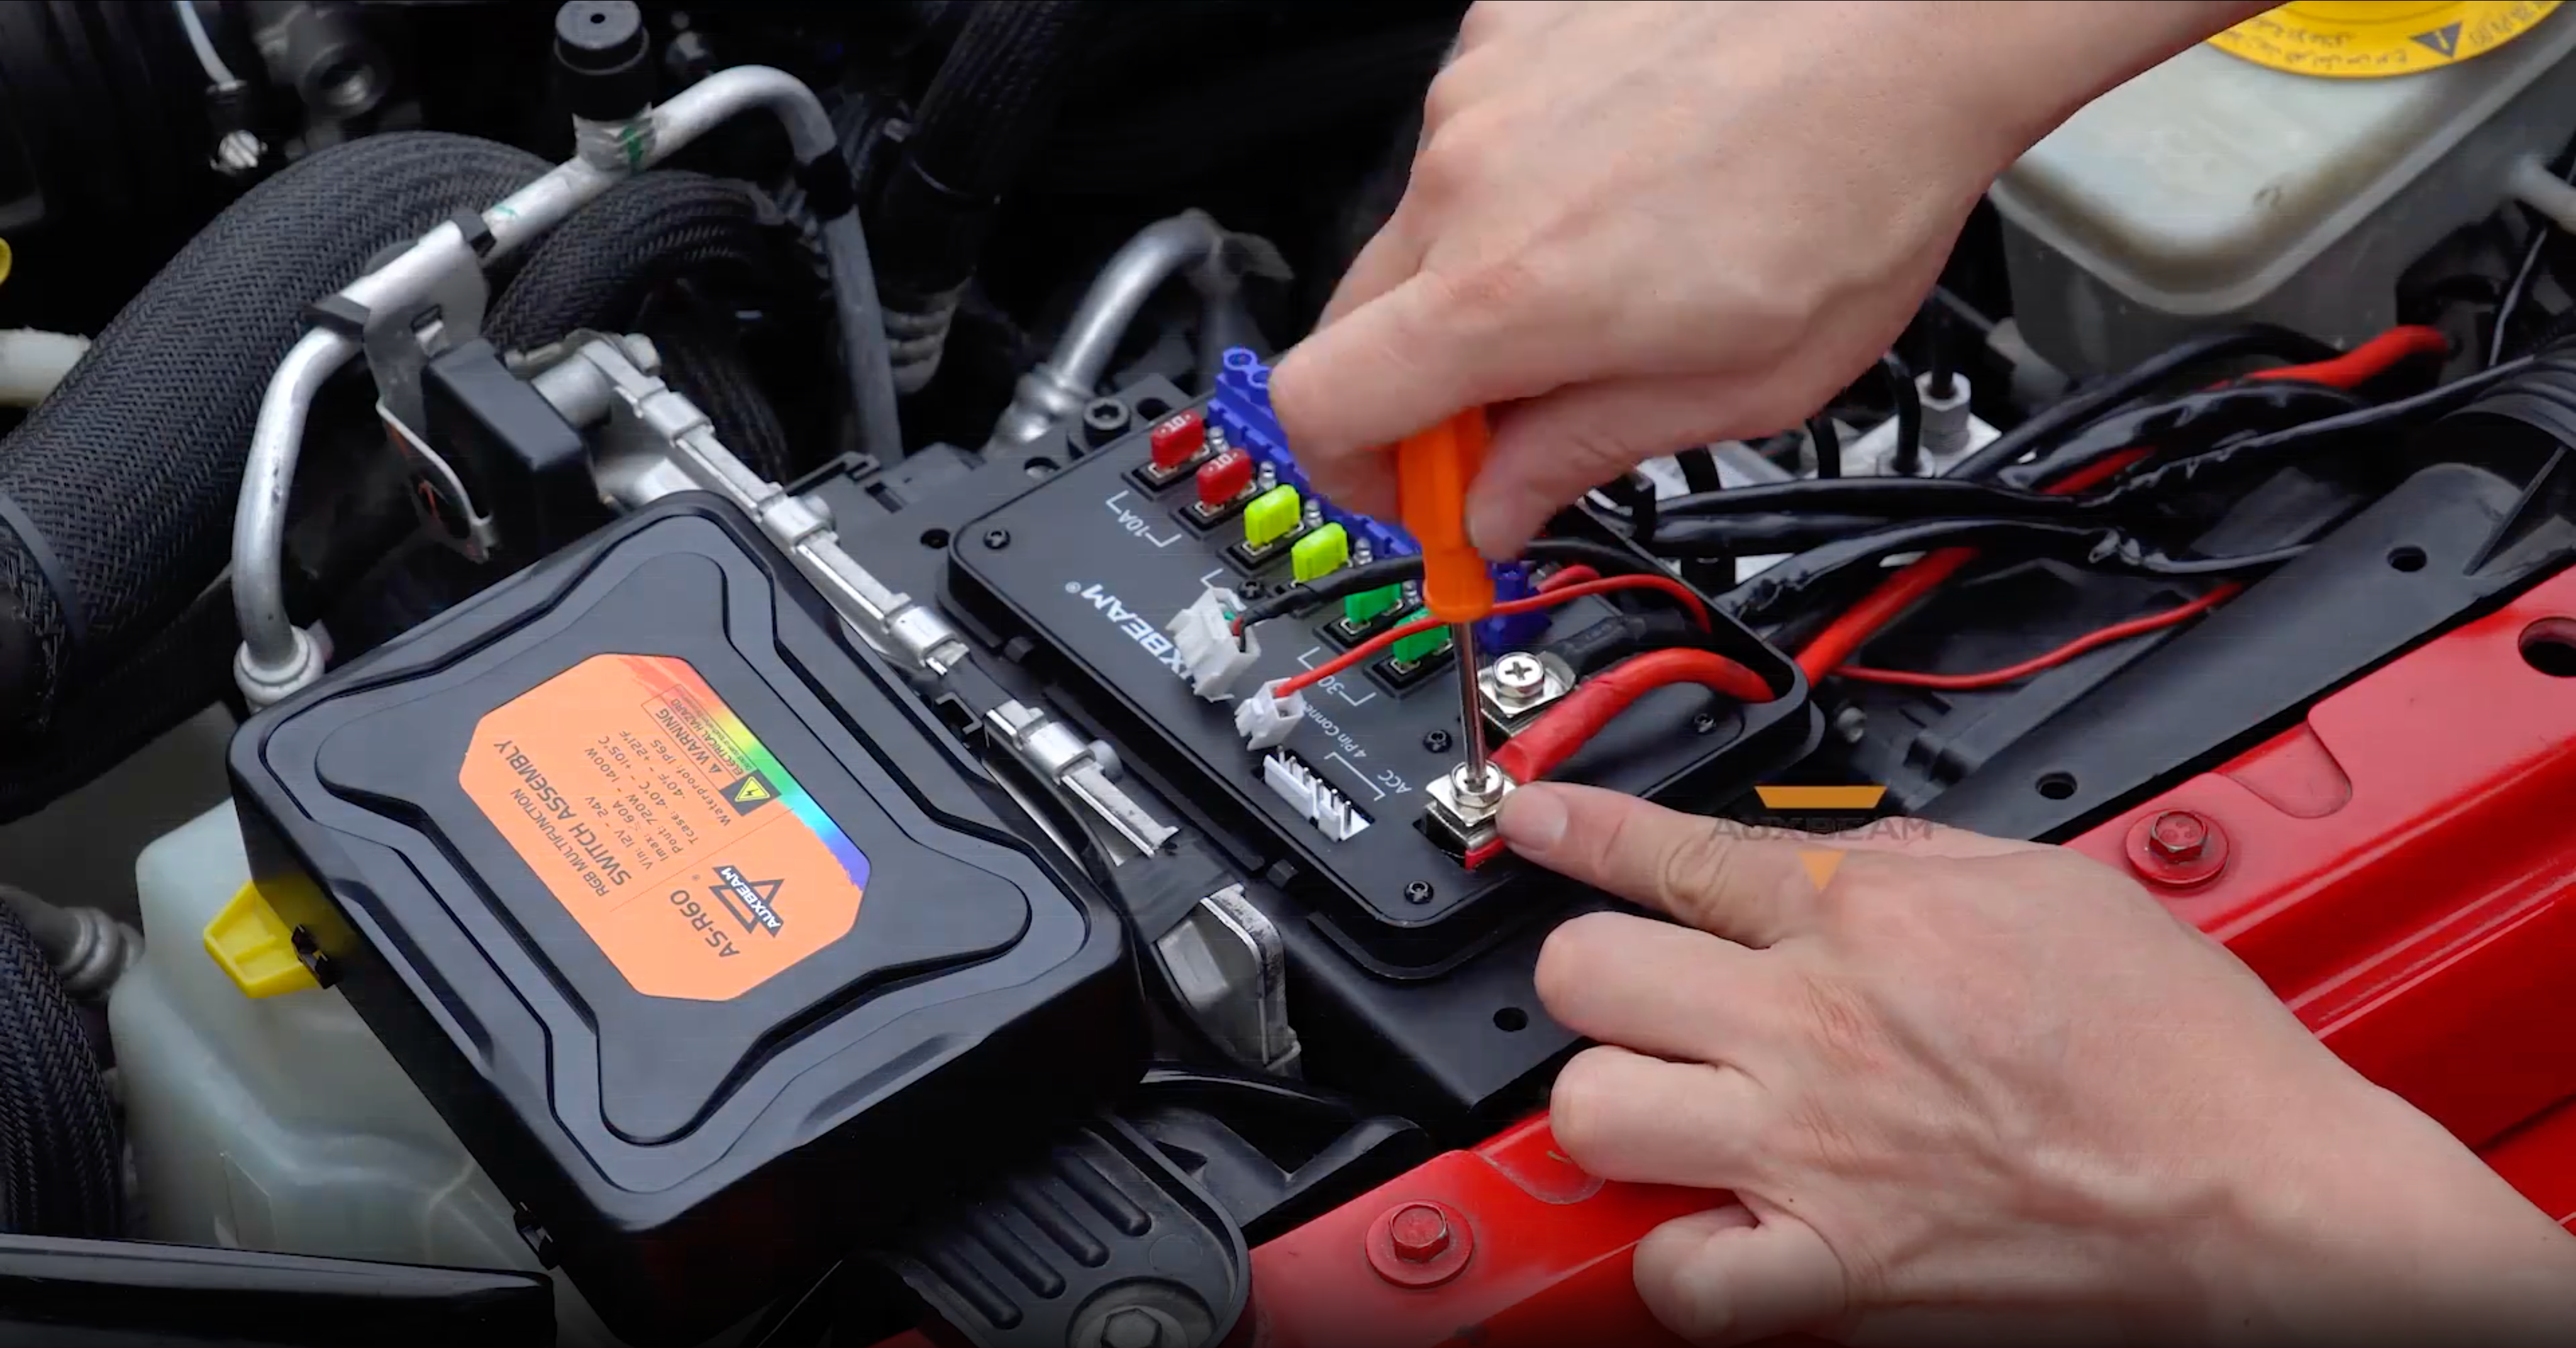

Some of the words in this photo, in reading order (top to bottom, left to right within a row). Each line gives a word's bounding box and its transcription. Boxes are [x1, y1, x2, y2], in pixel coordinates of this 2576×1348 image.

[1118, 509, 1150, 536] 10A
[1080, 583, 1192, 680] XBEAM
[1318, 675, 1345, 695] 30
[670, 699, 703, 732] HAZARD
[1304, 700, 1340, 736] Conne
[650, 739, 676, 765] IP65
[655, 708, 709, 765] WARNING
[702, 729, 744, 776] ELECTRICAL
[1338, 732, 1358, 752] Pin
[585, 748, 619, 782] 1400W
[1354, 749, 1367, 758] 4
[494, 740, 577, 820] ASSEMBLY
[676, 765, 731, 826] Waterproof:
[1377, 770, 1412, 793] ACC
[585, 796, 609, 817] 24V
[625, 794, 658, 825] 720W
[510, 788, 588, 871] MULTIFUNCTION
[614, 829, 635, 848] 12V
[658, 826, 684, 853] Pout:
[670, 811, 698, 845] Tcase:
[569, 822, 632, 885] SWITCH
[635, 848, 653, 870] Vin:
[644, 834, 669, 861] Imax:
[583, 871, 609, 897] RGB
[721, 867, 781, 928] AUXBEAM
[670, 890, 740, 957] AS-R60
